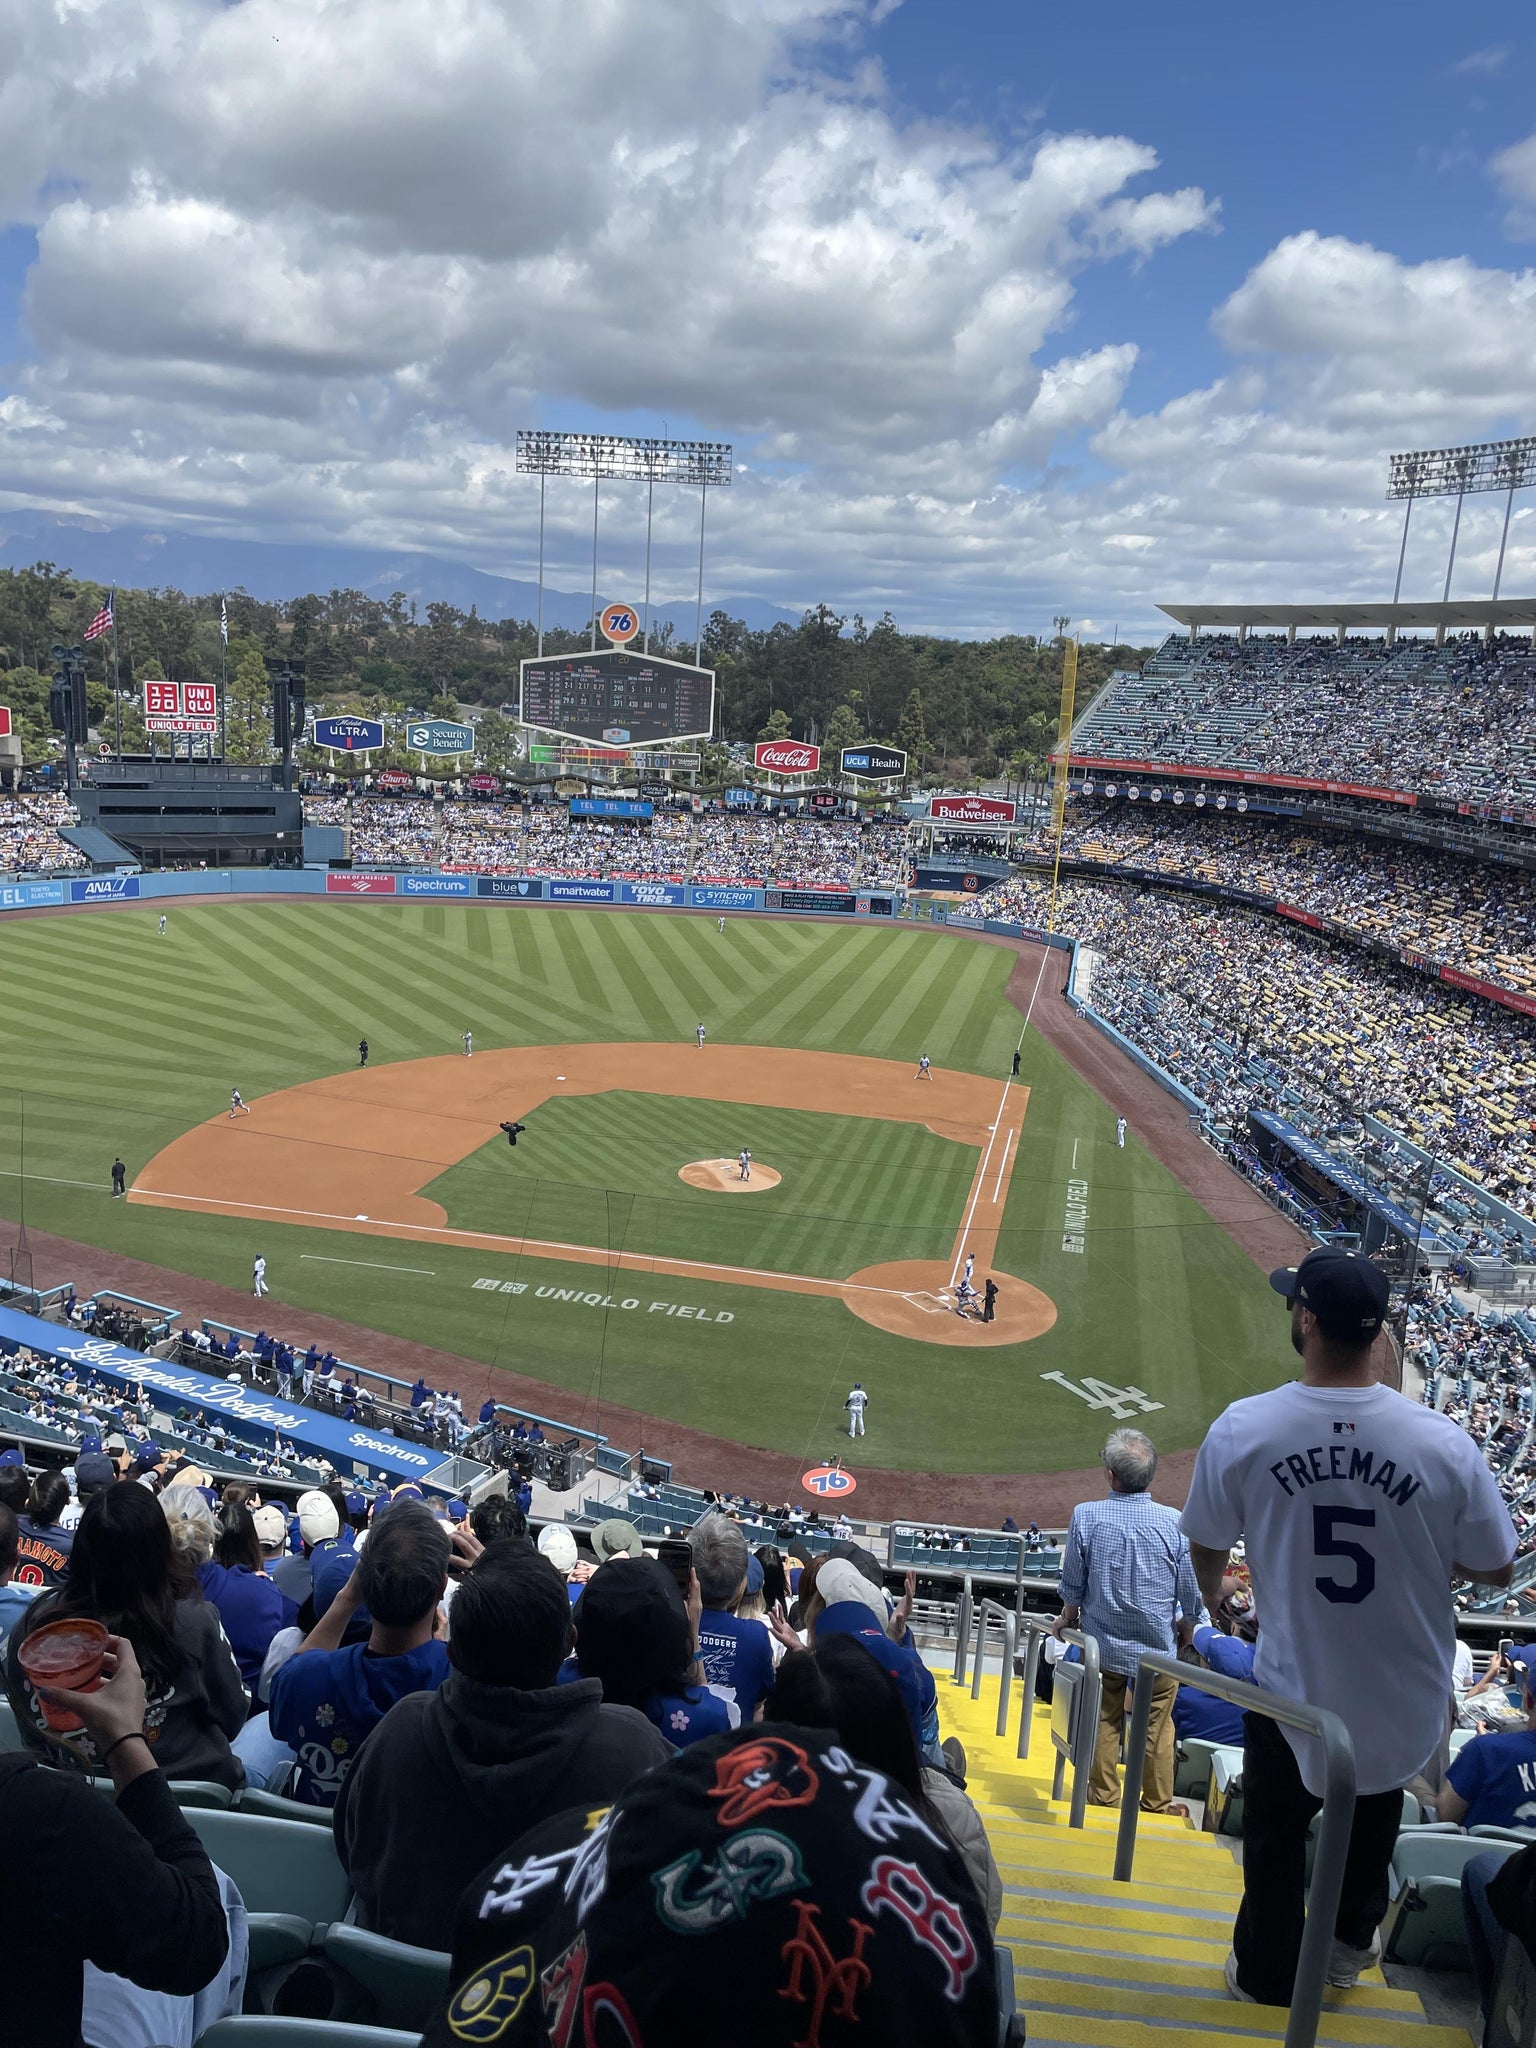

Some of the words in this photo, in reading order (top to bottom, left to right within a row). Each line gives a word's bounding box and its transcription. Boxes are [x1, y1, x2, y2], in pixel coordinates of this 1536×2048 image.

[610, 613, 631, 632] 76
[188, 688, 209, 699] UNI
[188, 700, 212, 712] QLO
[150, 720, 184, 731] UNIQLO
[186, 721, 212, 730] FIELD
[329, 726, 369, 737] ULTRA
[432, 729, 468, 740] Security
[433, 739, 463, 748] Benefit
[846, 757, 867, 767] UCLA
[871, 757, 901, 769] Health
[381, 773, 409, 784] Churu
[728, 790, 750, 801] TEL
[629, 804, 643, 812] TEL
[939, 806, 1005, 820] Budweiser
[85, 881, 112, 894] ANA
[407, 879, 460, 892] Spectrum
[492, 882, 518, 892] blue
[966, 878, 976, 888] 76
[0, 888, 24, 905] EL
[553, 885, 610, 898] smartwater
[631, 886, 665, 895] TOYO
[706, 891, 752, 901] SYNCRON
[636, 895, 673, 904] TIRES
[1022, 930, 1041, 940] Yakult
[1286, 1135, 1336, 1171] STADIUM
[1066, 1179, 1088, 1203] FIELD
[1064, 1202, 1090, 1234] UNIQLO
[534, 1286, 640, 1310] UNIQLO
[647, 1302, 735, 1324] FIELD
[57, 1341, 107, 1367] Los
[99, 1357, 203, 1397] Angeles
[190, 1383, 307, 1430] Dodgers
[1039, 1370, 1166, 1420] LA
[348, 1433, 426, 1466] Spectrum
[810, 1472, 850, 1494] 76
[1270, 1445, 1422, 1508] FREEMAN
[839, 1531, 847, 1539] 16
[1312, 1504, 1376, 1604] 5
[698, 1635, 737, 1649] DODGERS
[1517, 1762, 1536, 1792] K
[861, 1855, 957, 2000] B
